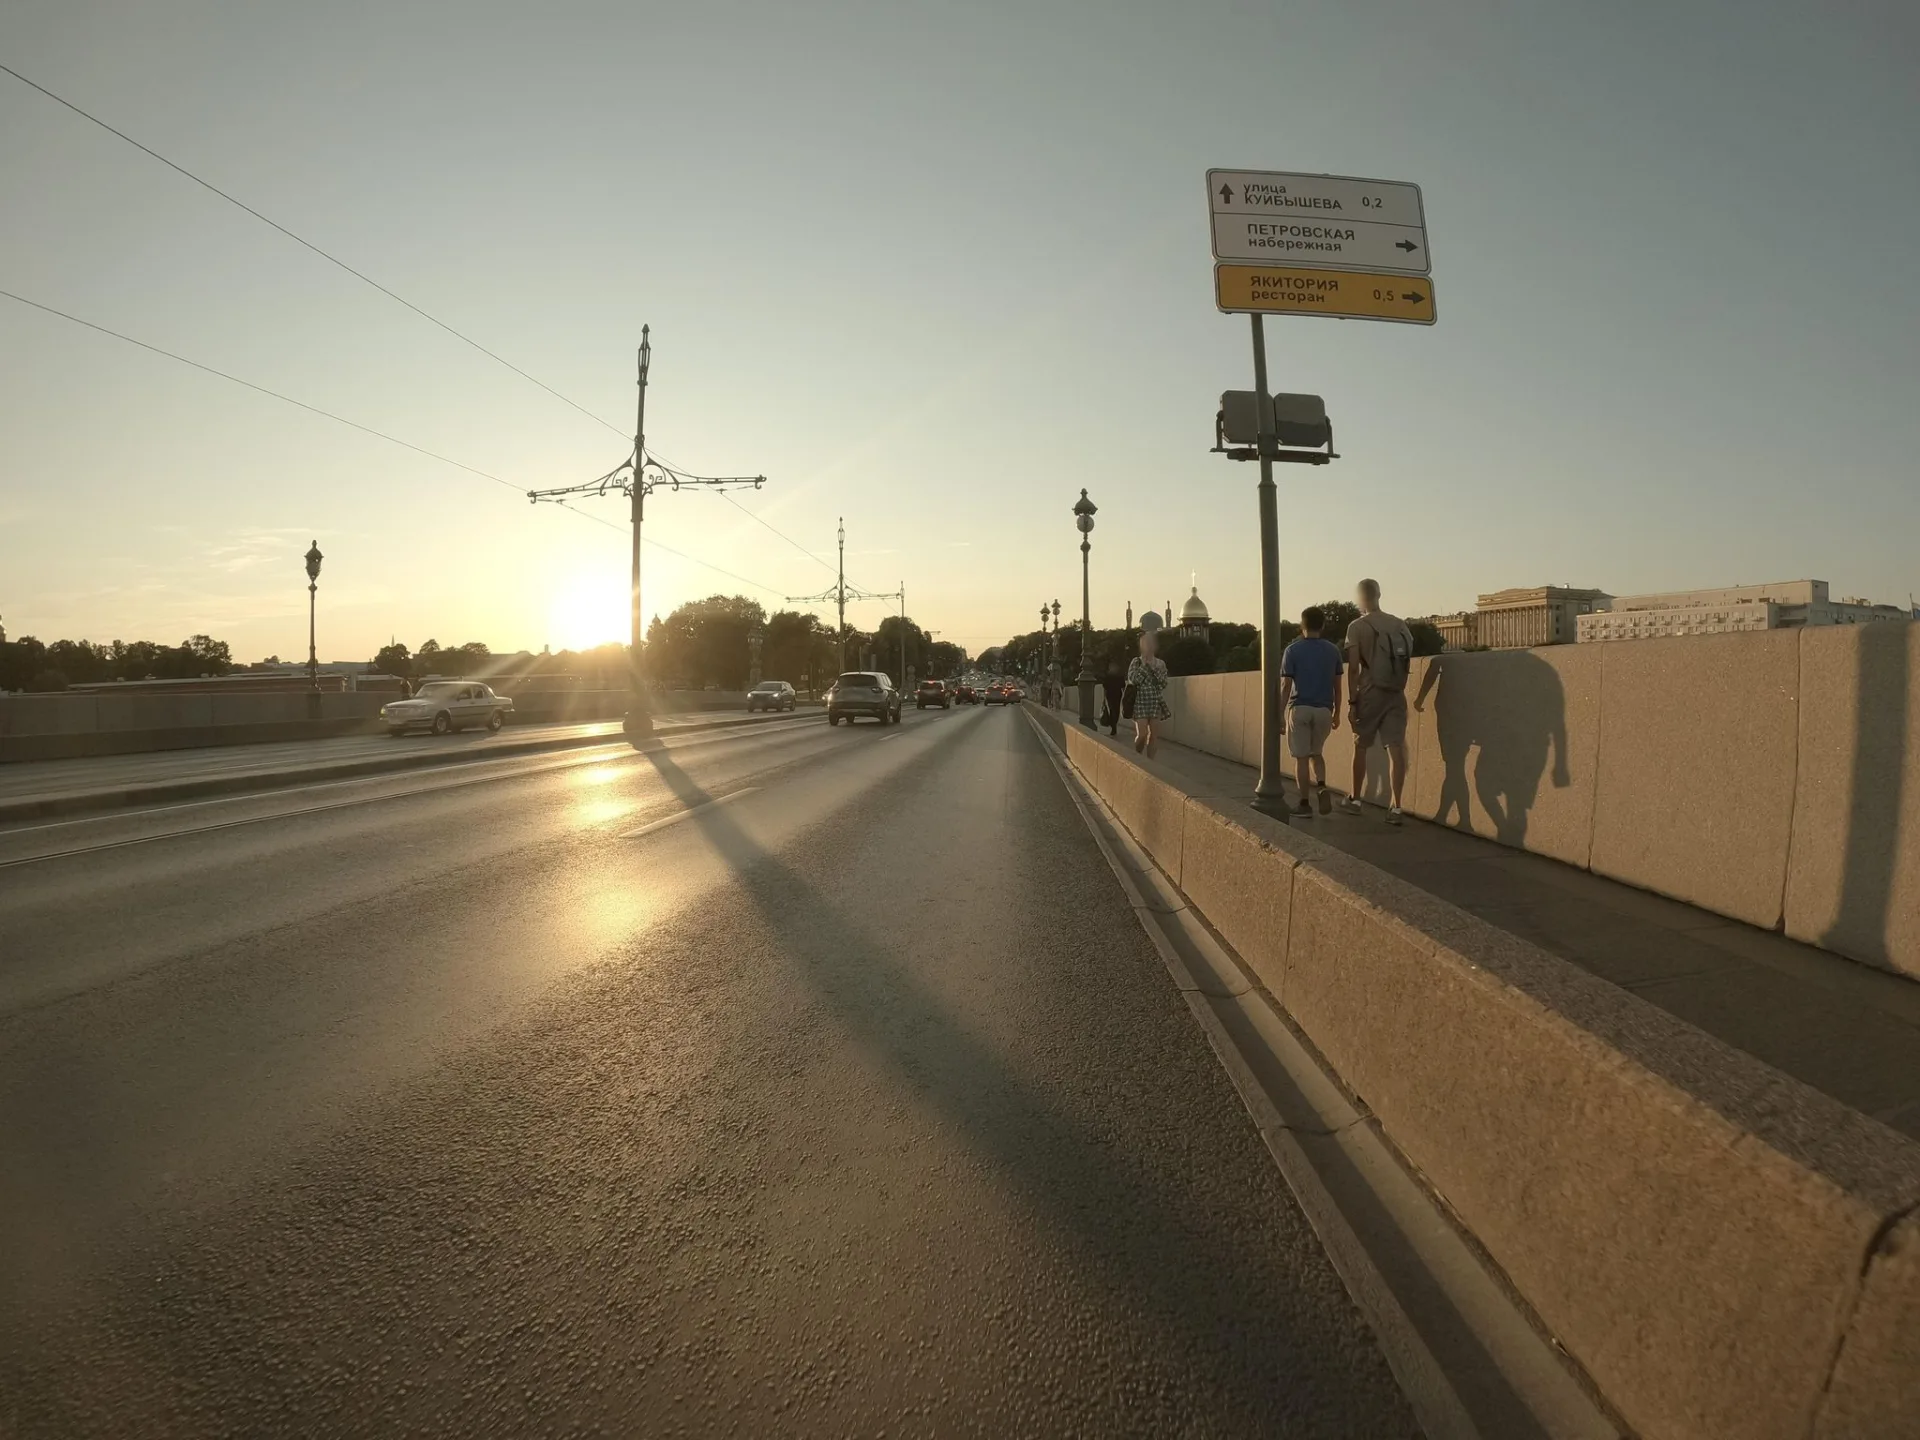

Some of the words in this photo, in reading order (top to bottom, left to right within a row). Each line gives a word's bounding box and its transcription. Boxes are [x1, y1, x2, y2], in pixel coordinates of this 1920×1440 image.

[1243, 183, 1287, 195] улица
[1244, 193, 1343, 210] КУЙБЫШЕВА
[1362, 196, 1383, 209] 0,2
[1247, 223, 1355, 240] ПЕТРОВСКАЯ
[1248, 237, 1342, 252] набережная
[1250, 275, 1339, 291] ЯКИТОРИЯ
[1251, 289, 1325, 304] ресторан
[1373, 289, 1394, 302] 0,5
